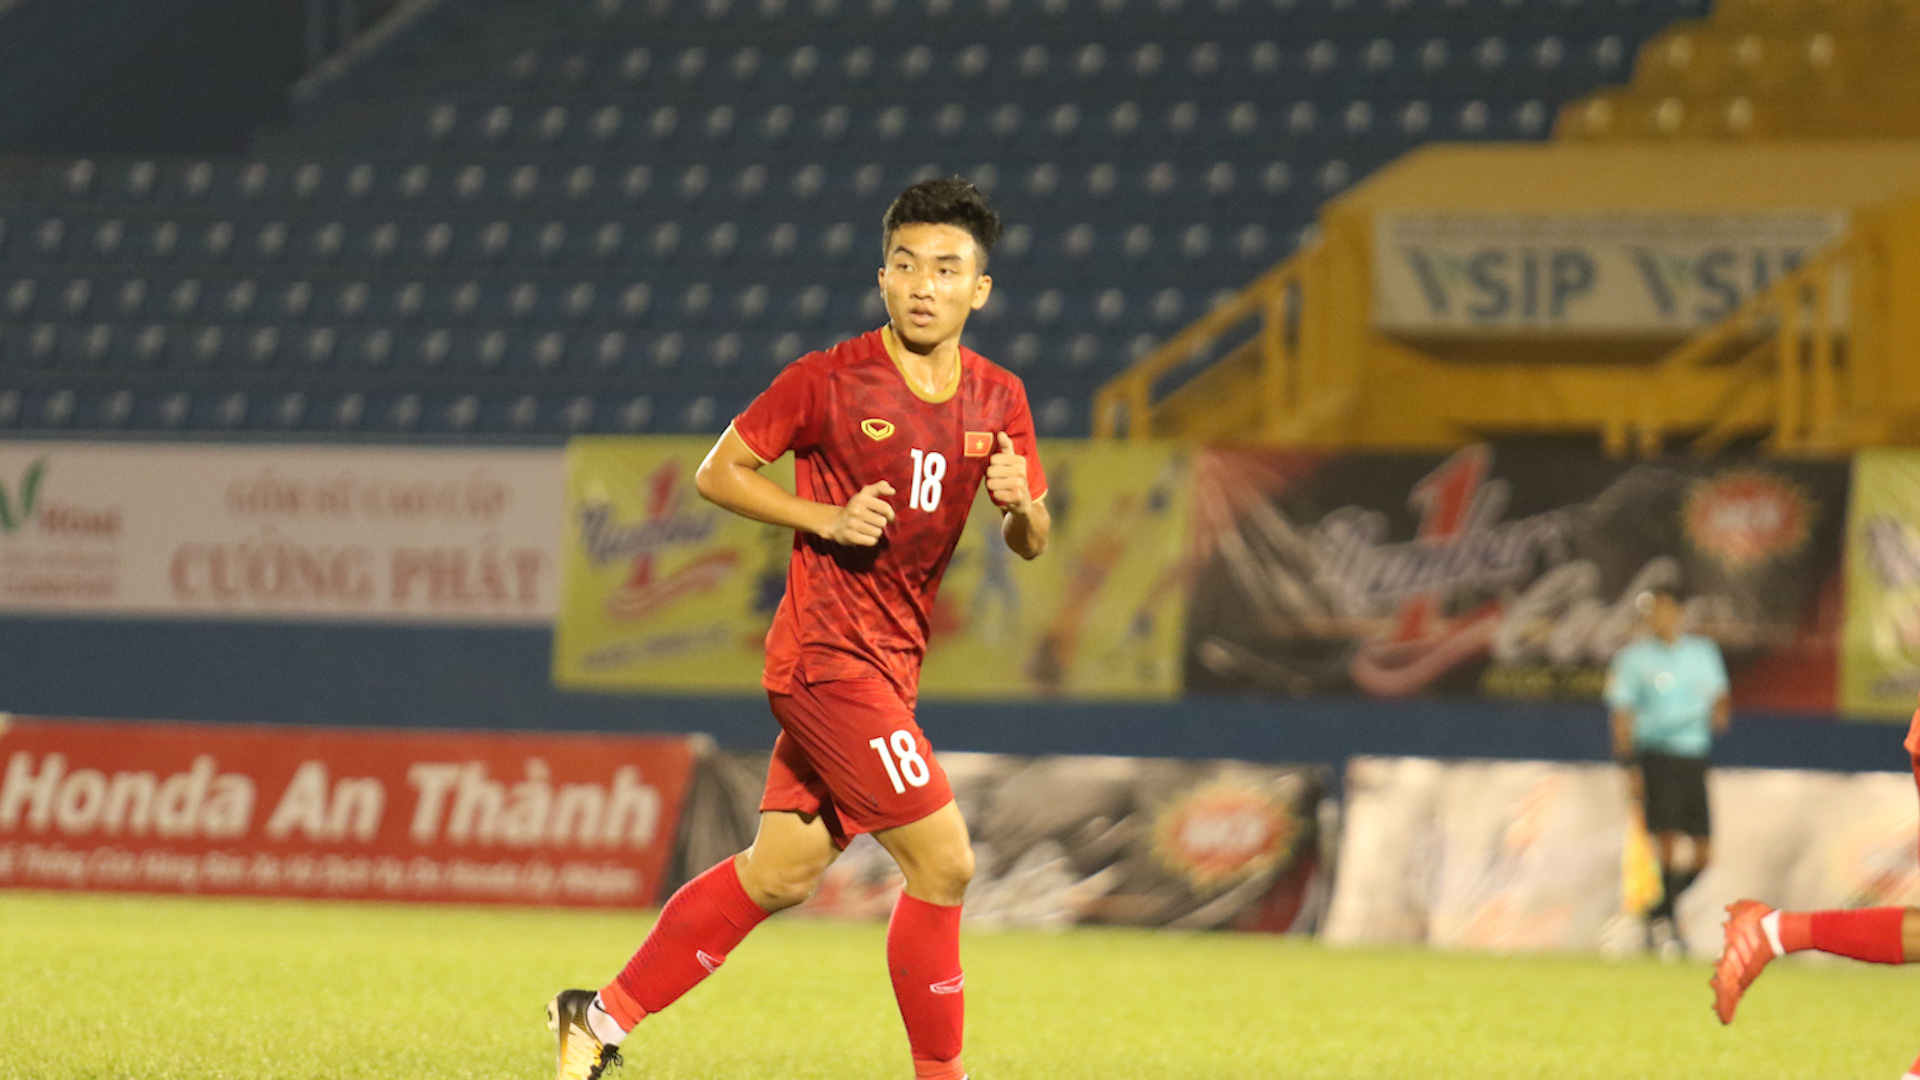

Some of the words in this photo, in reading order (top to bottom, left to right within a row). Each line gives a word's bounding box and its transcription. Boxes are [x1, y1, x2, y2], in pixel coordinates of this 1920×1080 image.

[1397, 245, 1597, 321] VSIP
[1622, 245, 1806, 323] VSI
[909, 448, 946, 512] 18
[169, 525, 375, 602] CƯỜNG
[0, 752, 256, 836] Honda
[267, 760, 386, 842] An
[406, 758, 662, 849] Thành
[869, 730, 930, 794] 18
